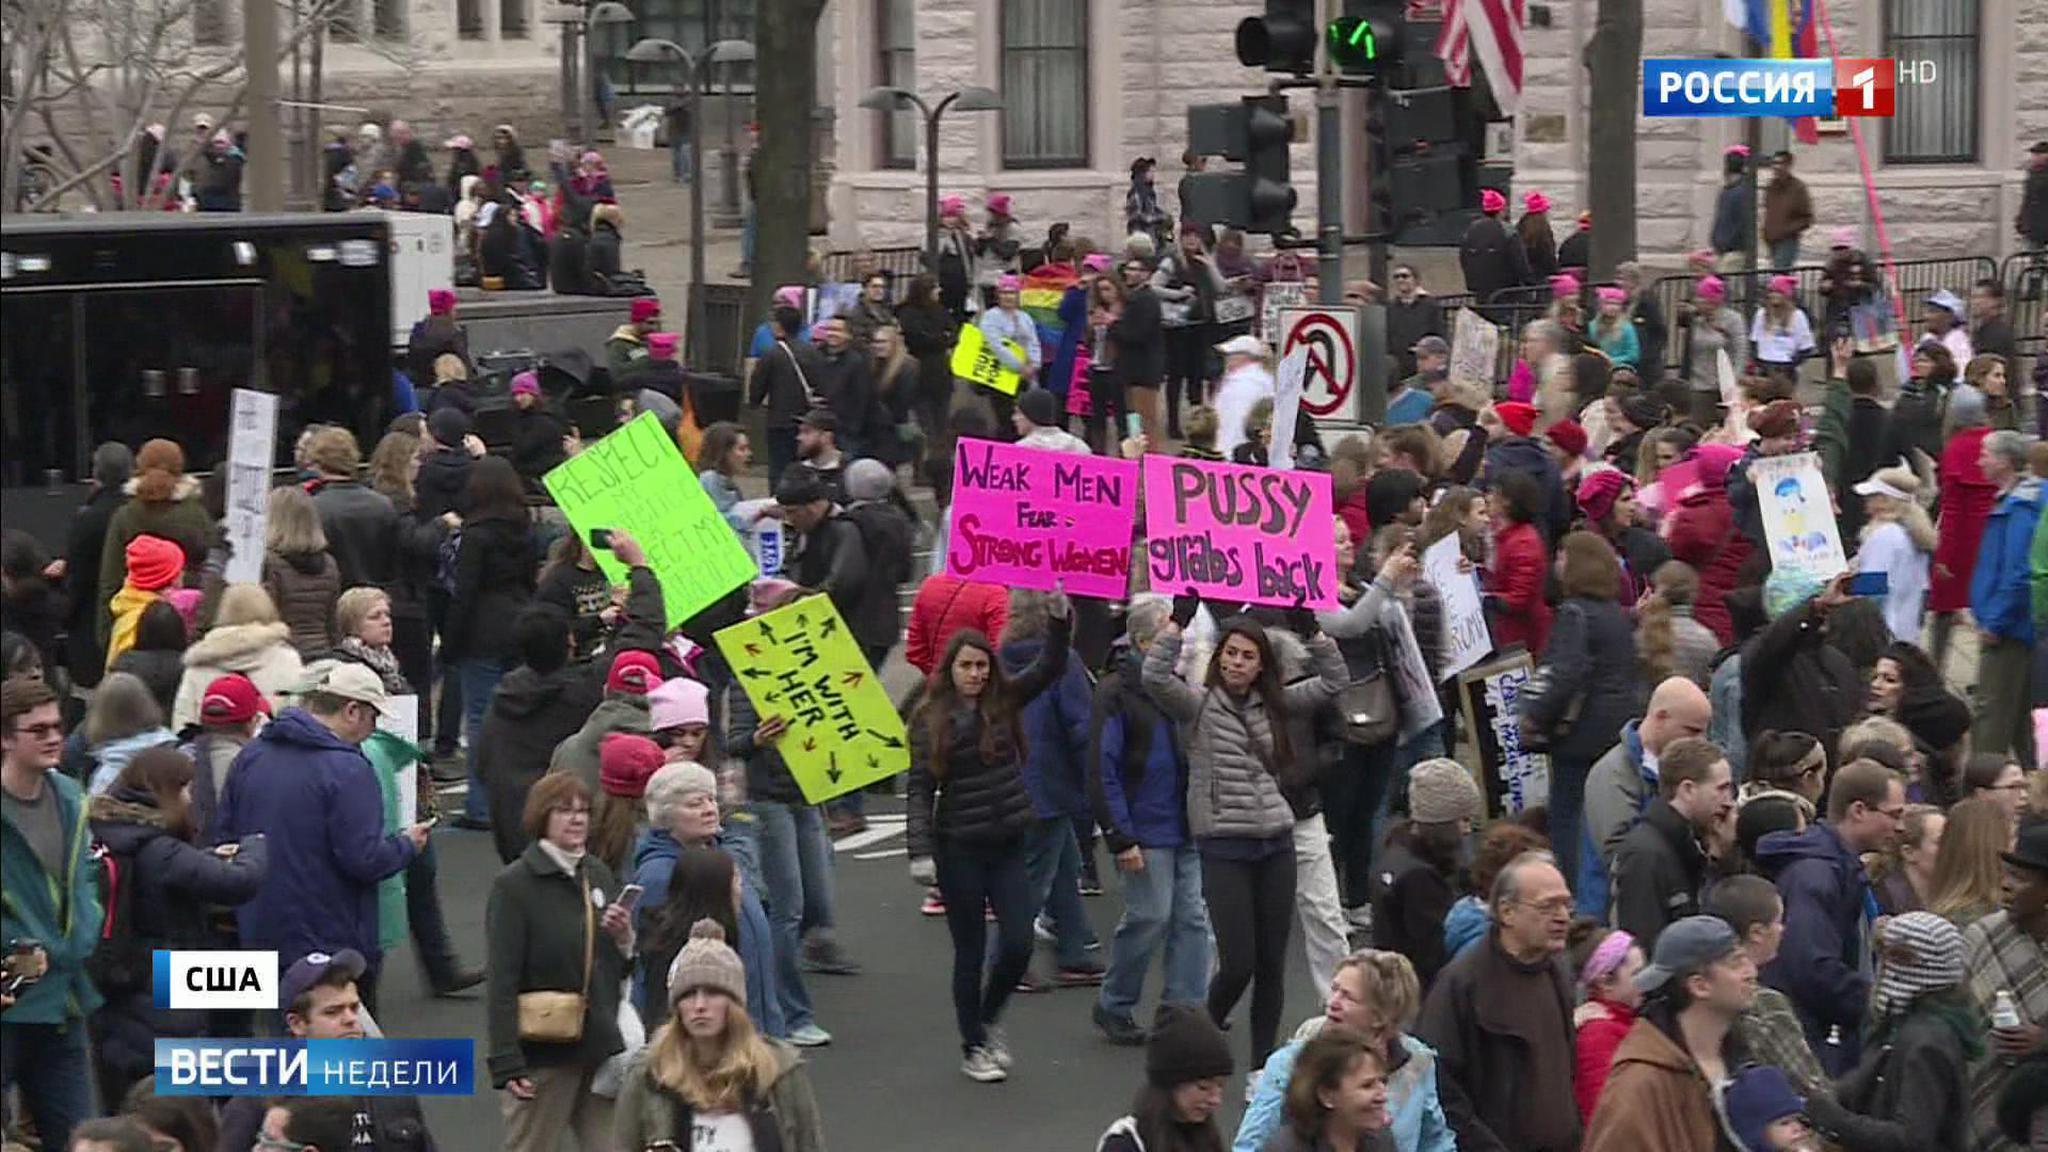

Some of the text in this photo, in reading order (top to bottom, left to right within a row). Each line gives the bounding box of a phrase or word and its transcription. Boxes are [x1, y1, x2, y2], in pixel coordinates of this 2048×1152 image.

[549, 417, 671, 512] RESPECT
[958, 443, 1122, 507] WEAK MEN
[1172, 462, 1313, 538] PUSSY
[950, 514, 1128, 578] STRONG WOMEN
[1150, 531, 1325, 601] grabs back
[776, 669, 826, 728] HER
[783, 631, 861, 742] I'M WITH
